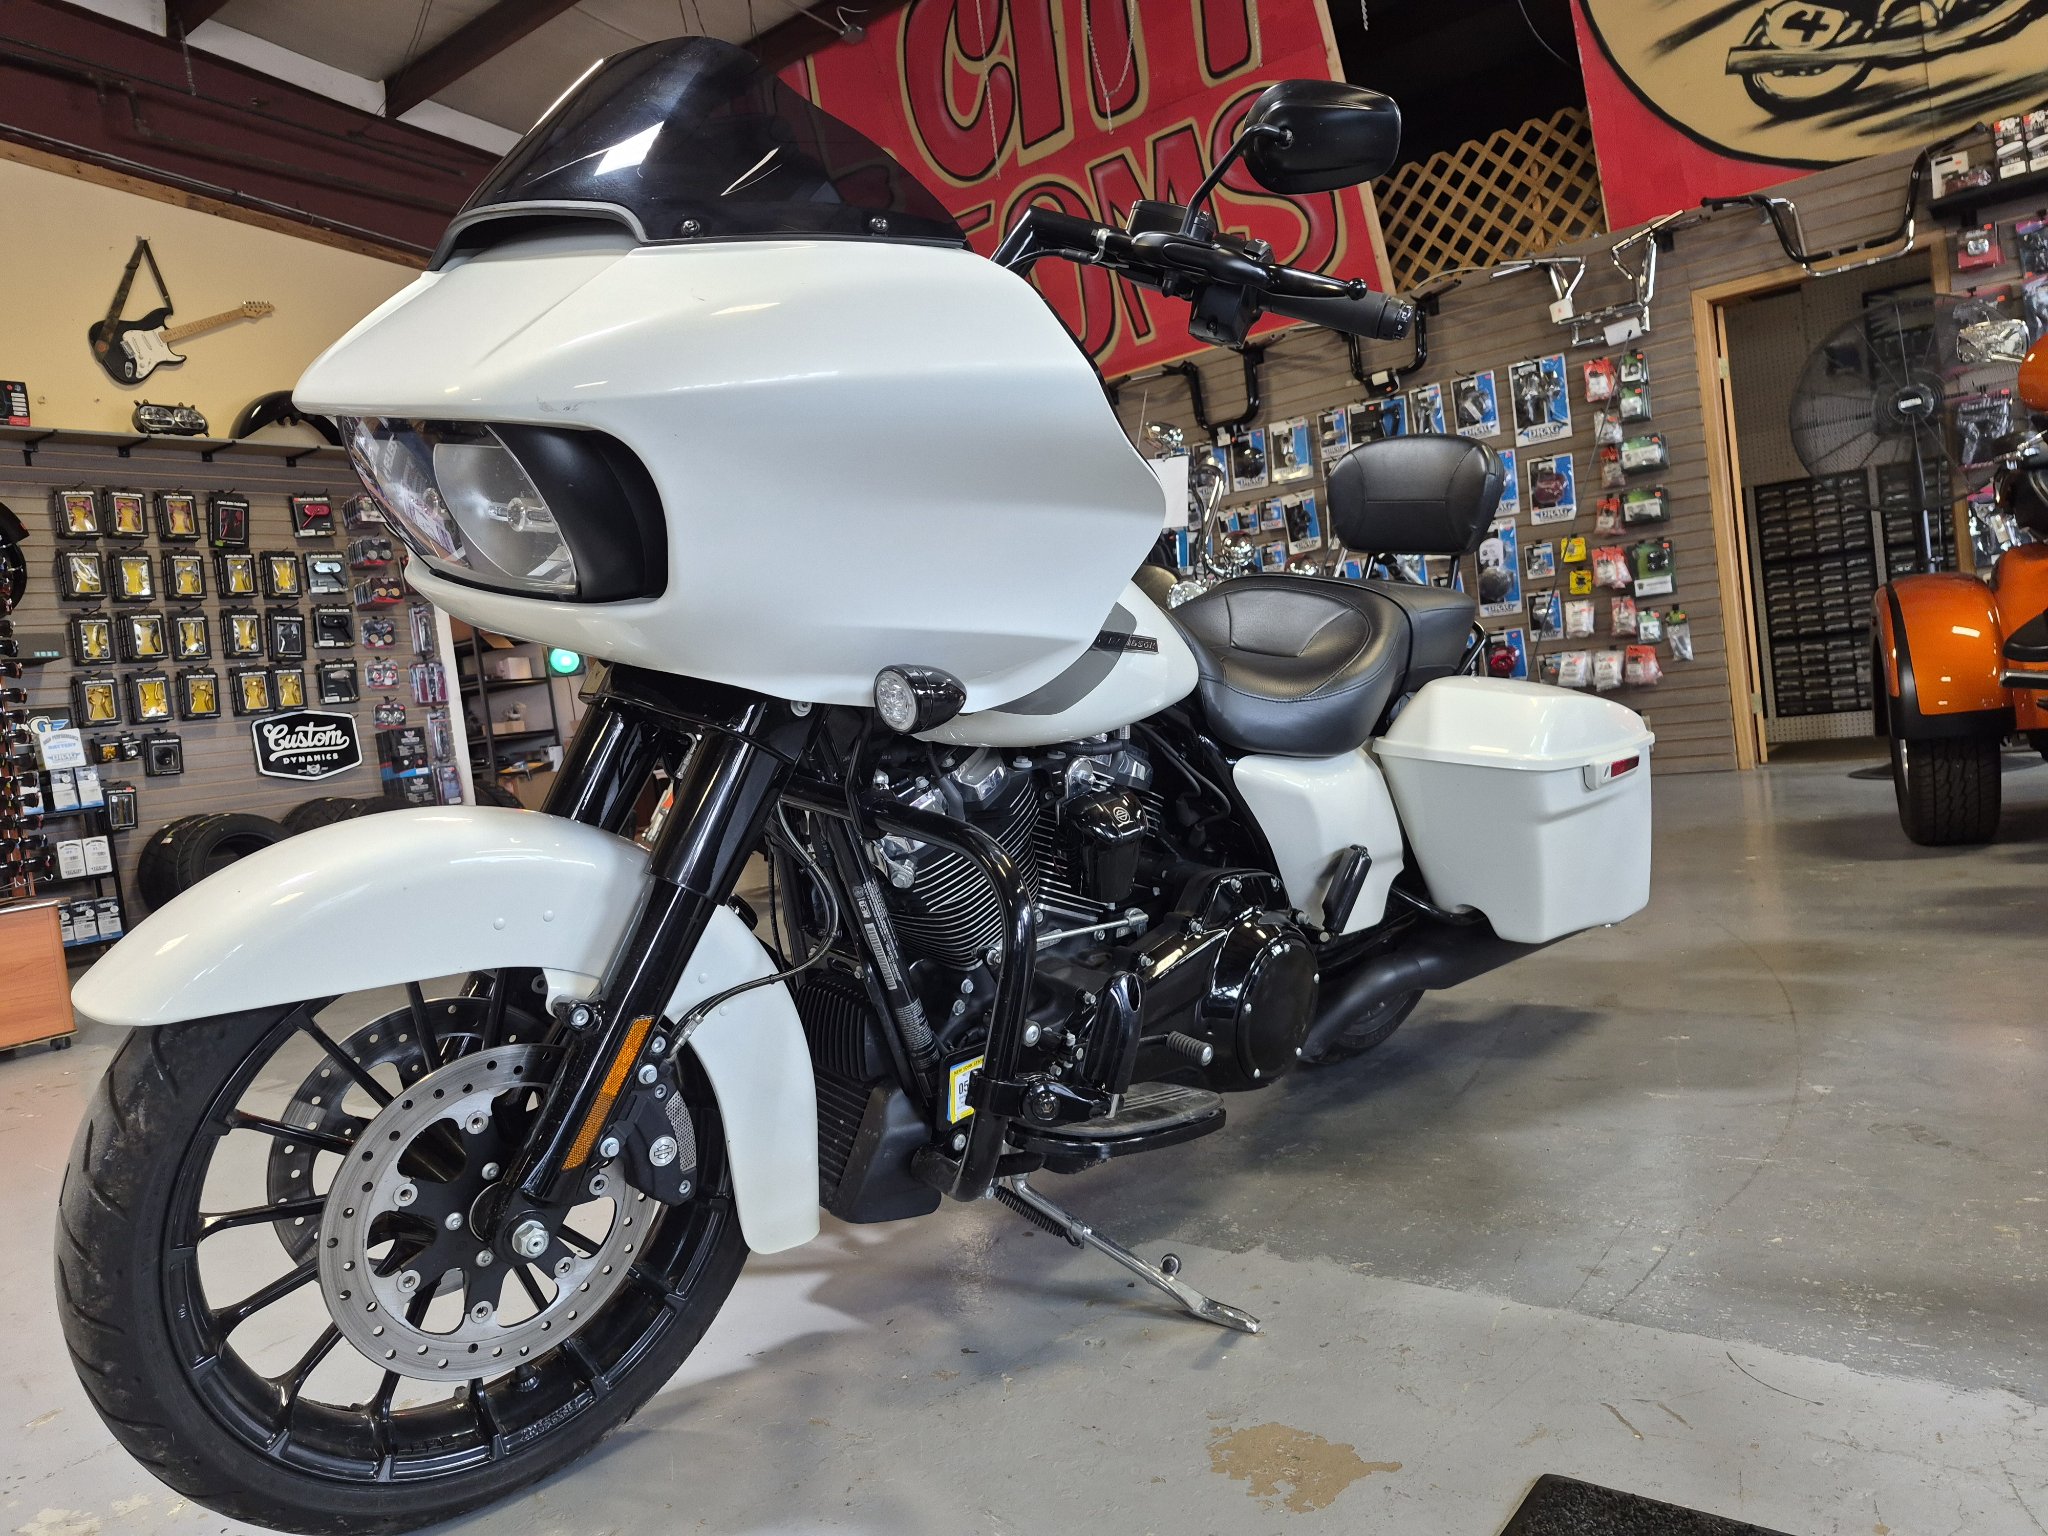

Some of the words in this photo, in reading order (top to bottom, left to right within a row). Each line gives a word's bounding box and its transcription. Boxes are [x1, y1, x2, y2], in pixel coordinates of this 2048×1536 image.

[1782, 9, 1830, 43] 4
[263, 721, 350, 753] Custom
[282, 752, 339, 765] DYNAMICS
